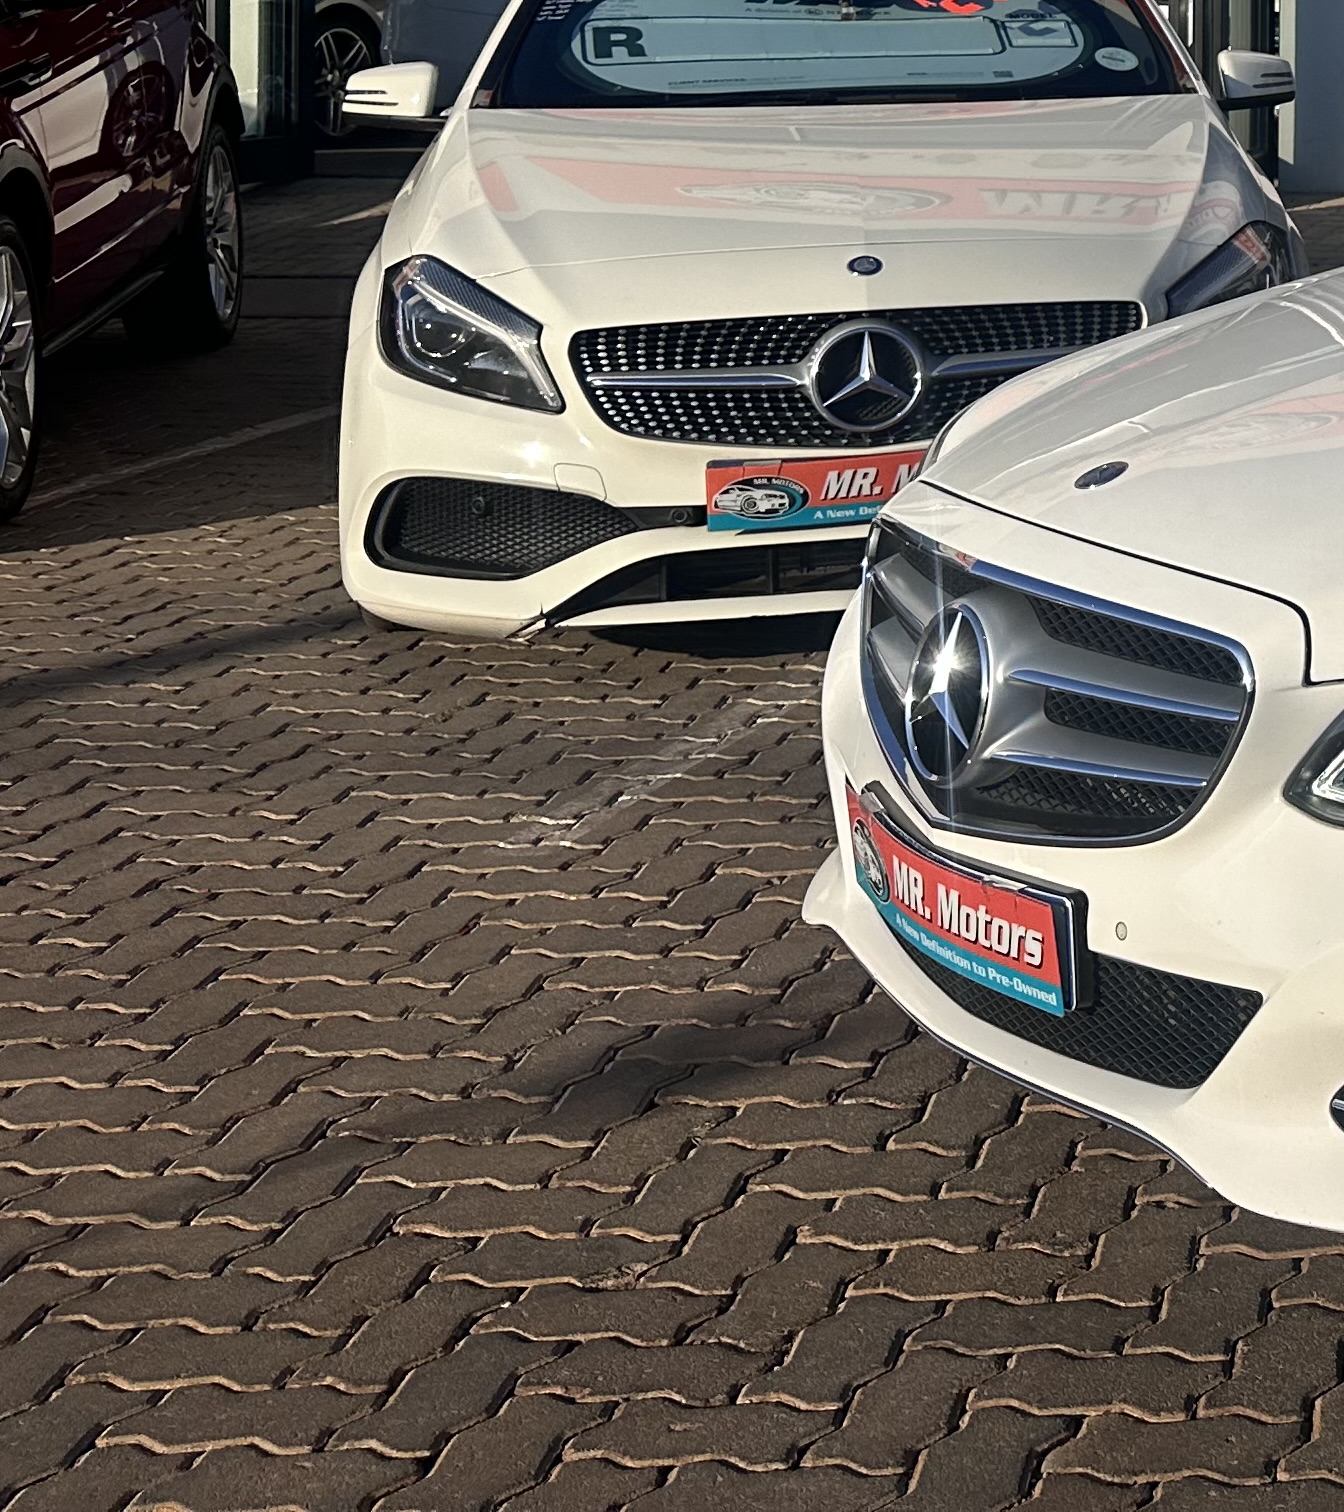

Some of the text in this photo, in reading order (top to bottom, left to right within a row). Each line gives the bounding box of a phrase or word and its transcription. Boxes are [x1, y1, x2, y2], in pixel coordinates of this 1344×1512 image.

[592, 25, 649, 60] R
[820, 466, 884, 502] MR.
[813, 509, 825, 520] A
[826, 508, 857, 519] New
[891, 853, 932, 921] MR.
[937, 882, 1045, 969] Motors
[920, 931, 971, 971] Definition
[972, 961, 987, 978] to
[987, 966, 1058, 1007] Pre-Owned
